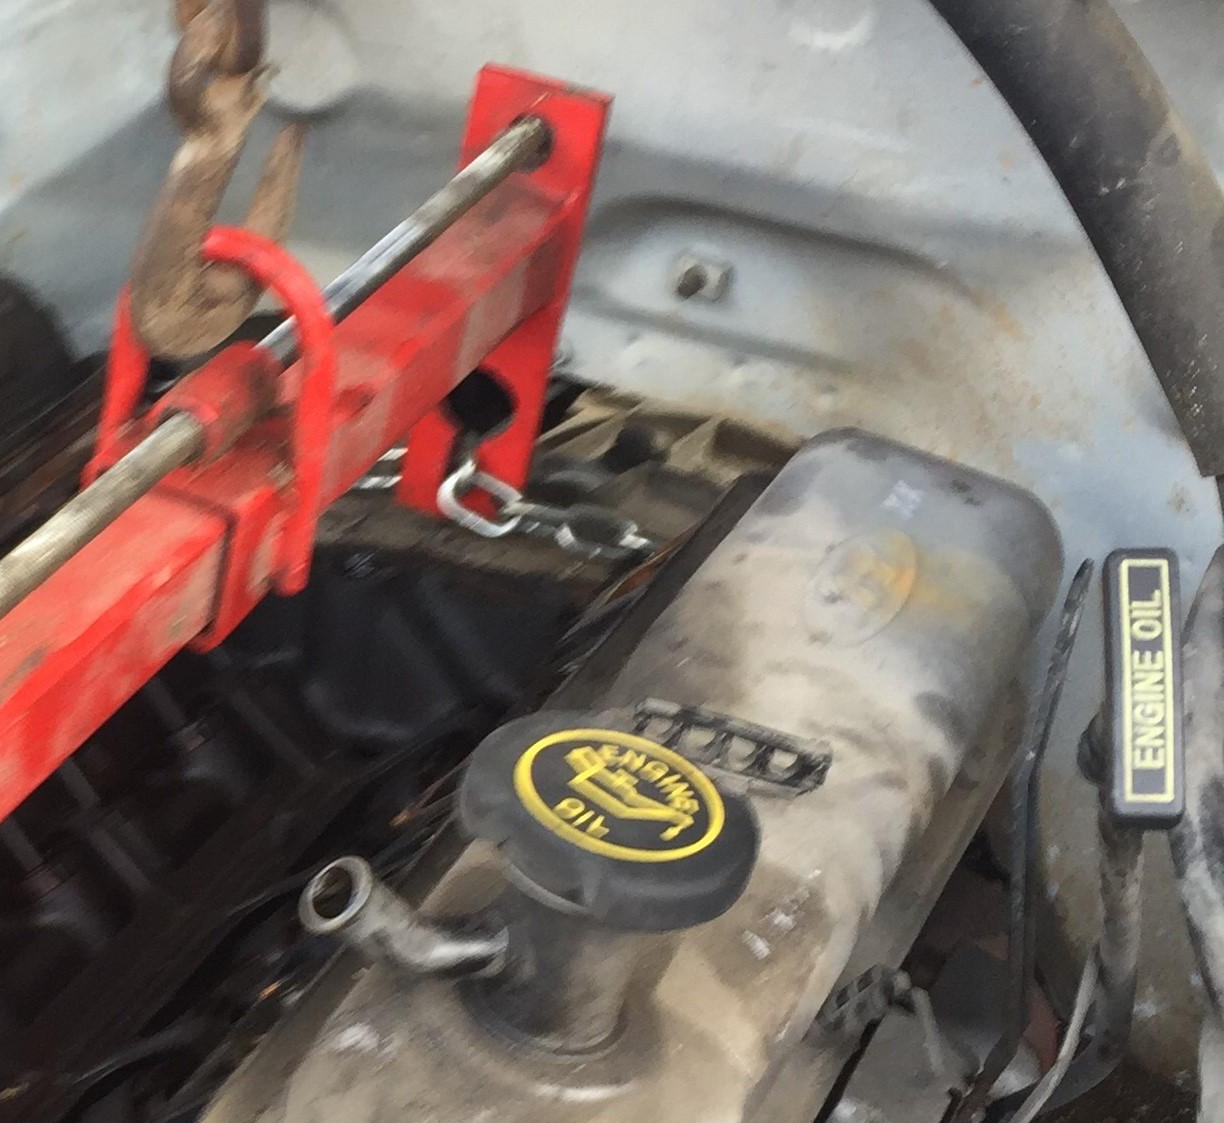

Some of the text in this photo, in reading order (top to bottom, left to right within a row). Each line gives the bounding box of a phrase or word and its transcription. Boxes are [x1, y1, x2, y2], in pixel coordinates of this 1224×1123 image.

[1129, 589, 1166, 770] ENGINE OIL
[551, 743, 700, 839] ENGINE OIL
